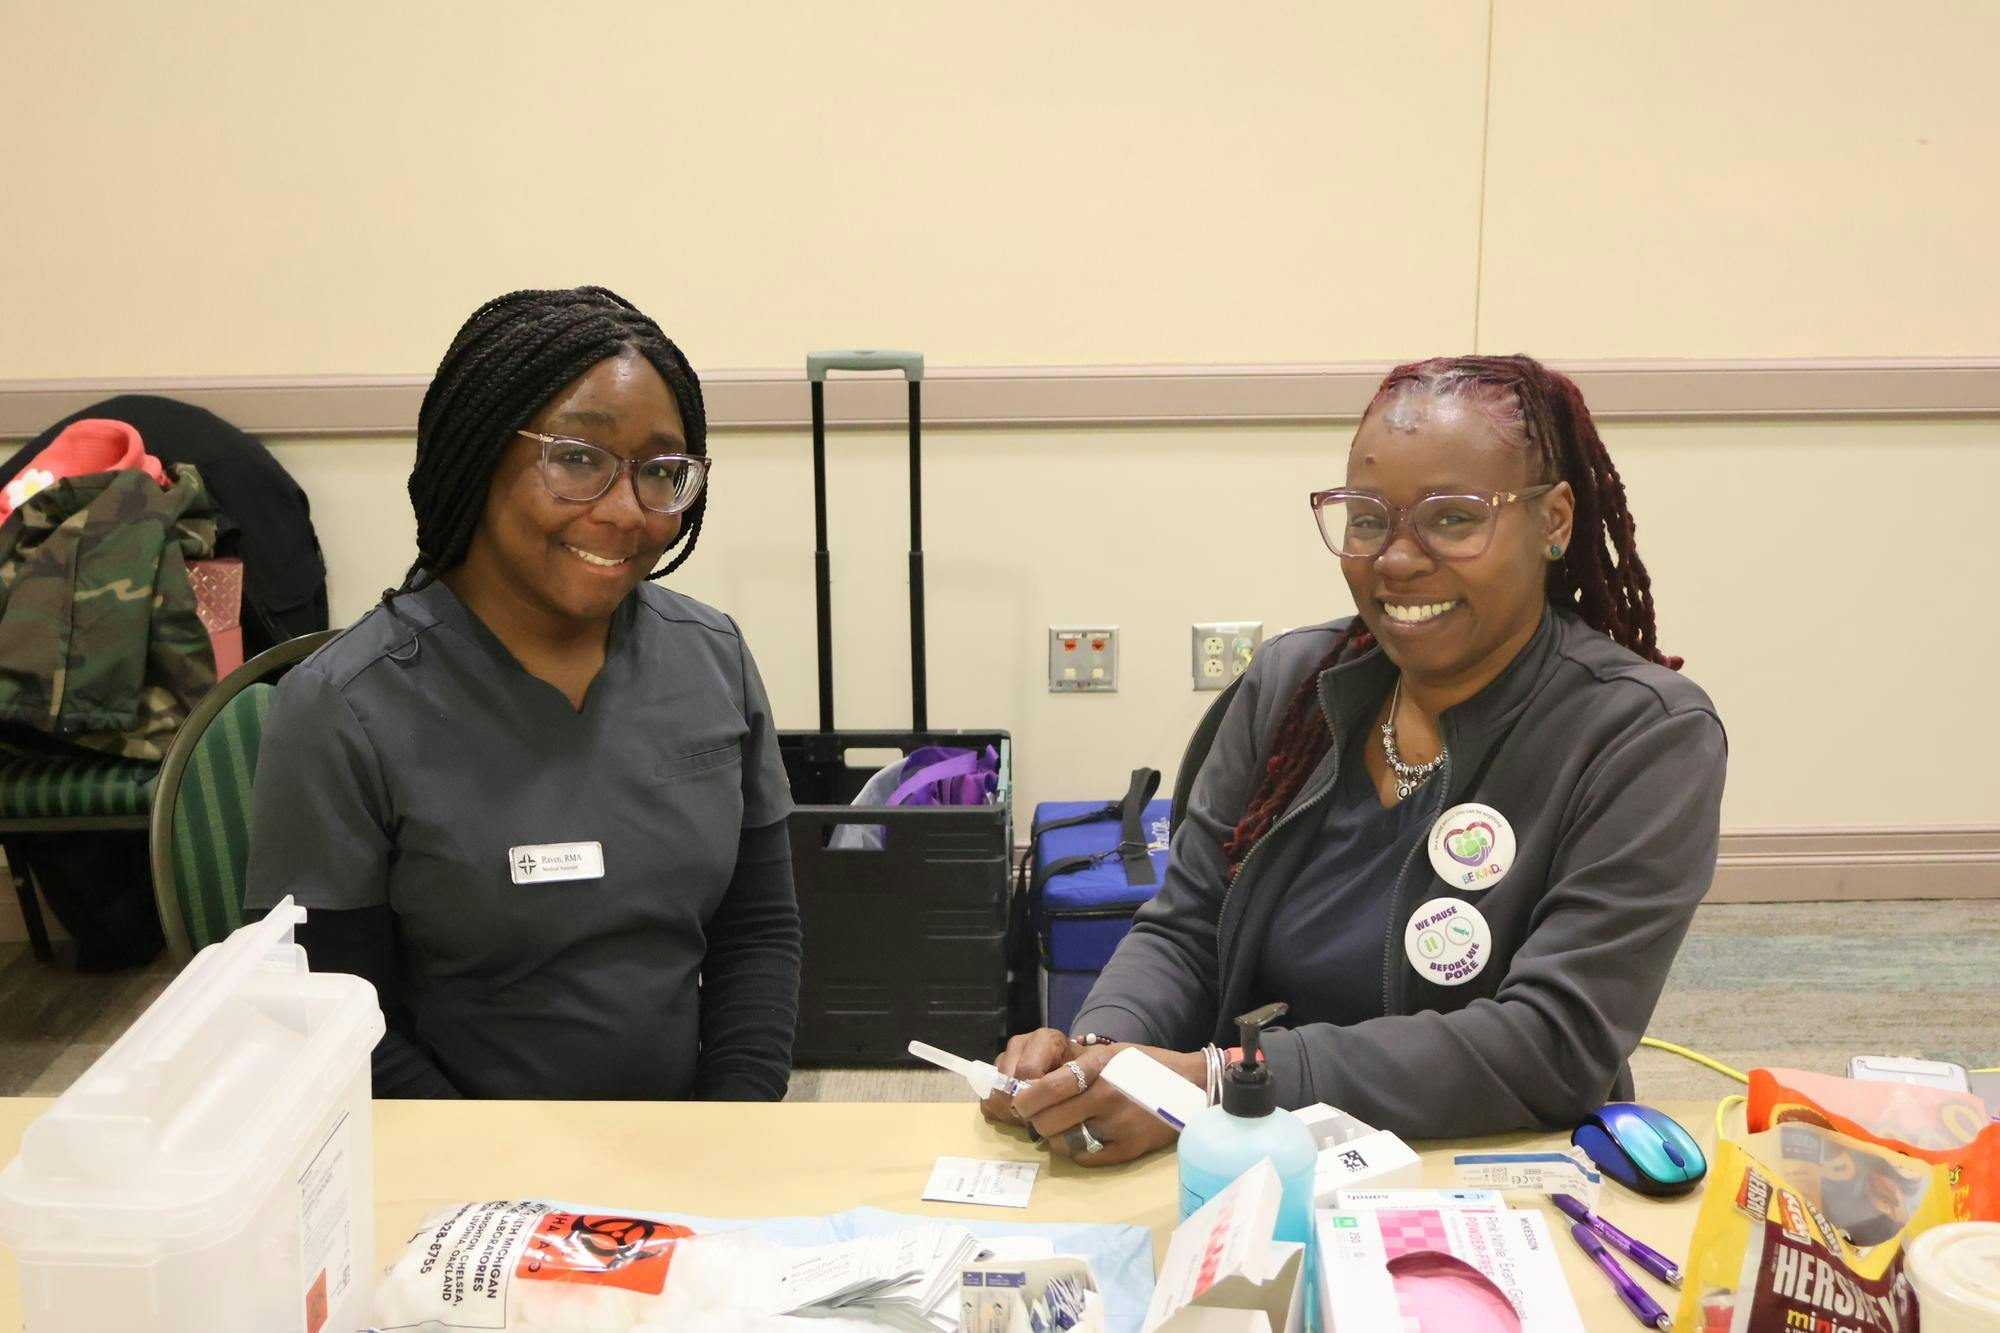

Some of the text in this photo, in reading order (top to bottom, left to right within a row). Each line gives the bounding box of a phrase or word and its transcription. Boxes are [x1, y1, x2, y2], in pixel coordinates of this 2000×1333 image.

[541, 853, 582, 864] Raven, RMA
[1461, 871, 1475, 885] BE
[1414, 905, 1458, 931] WE PAUSE
[1429, 941, 1480, 973] BEFORE WE
[1444, 959, 1480, 981] POKE
[453, 1214, 482, 1249] LIVONIA,
[1349, 1231, 1361, 1244] 250
[473, 1214, 510, 1292] LABORATORIES
[1486, 1216, 1499, 1233] Pink
[1499, 1261, 1516, 1286] Exam
[442, 1249, 461, 1301] OAKLAND
[452, 1255, 469, 1307] CHELSEA,
[486, 1237, 514, 1299] MICHIGAN
